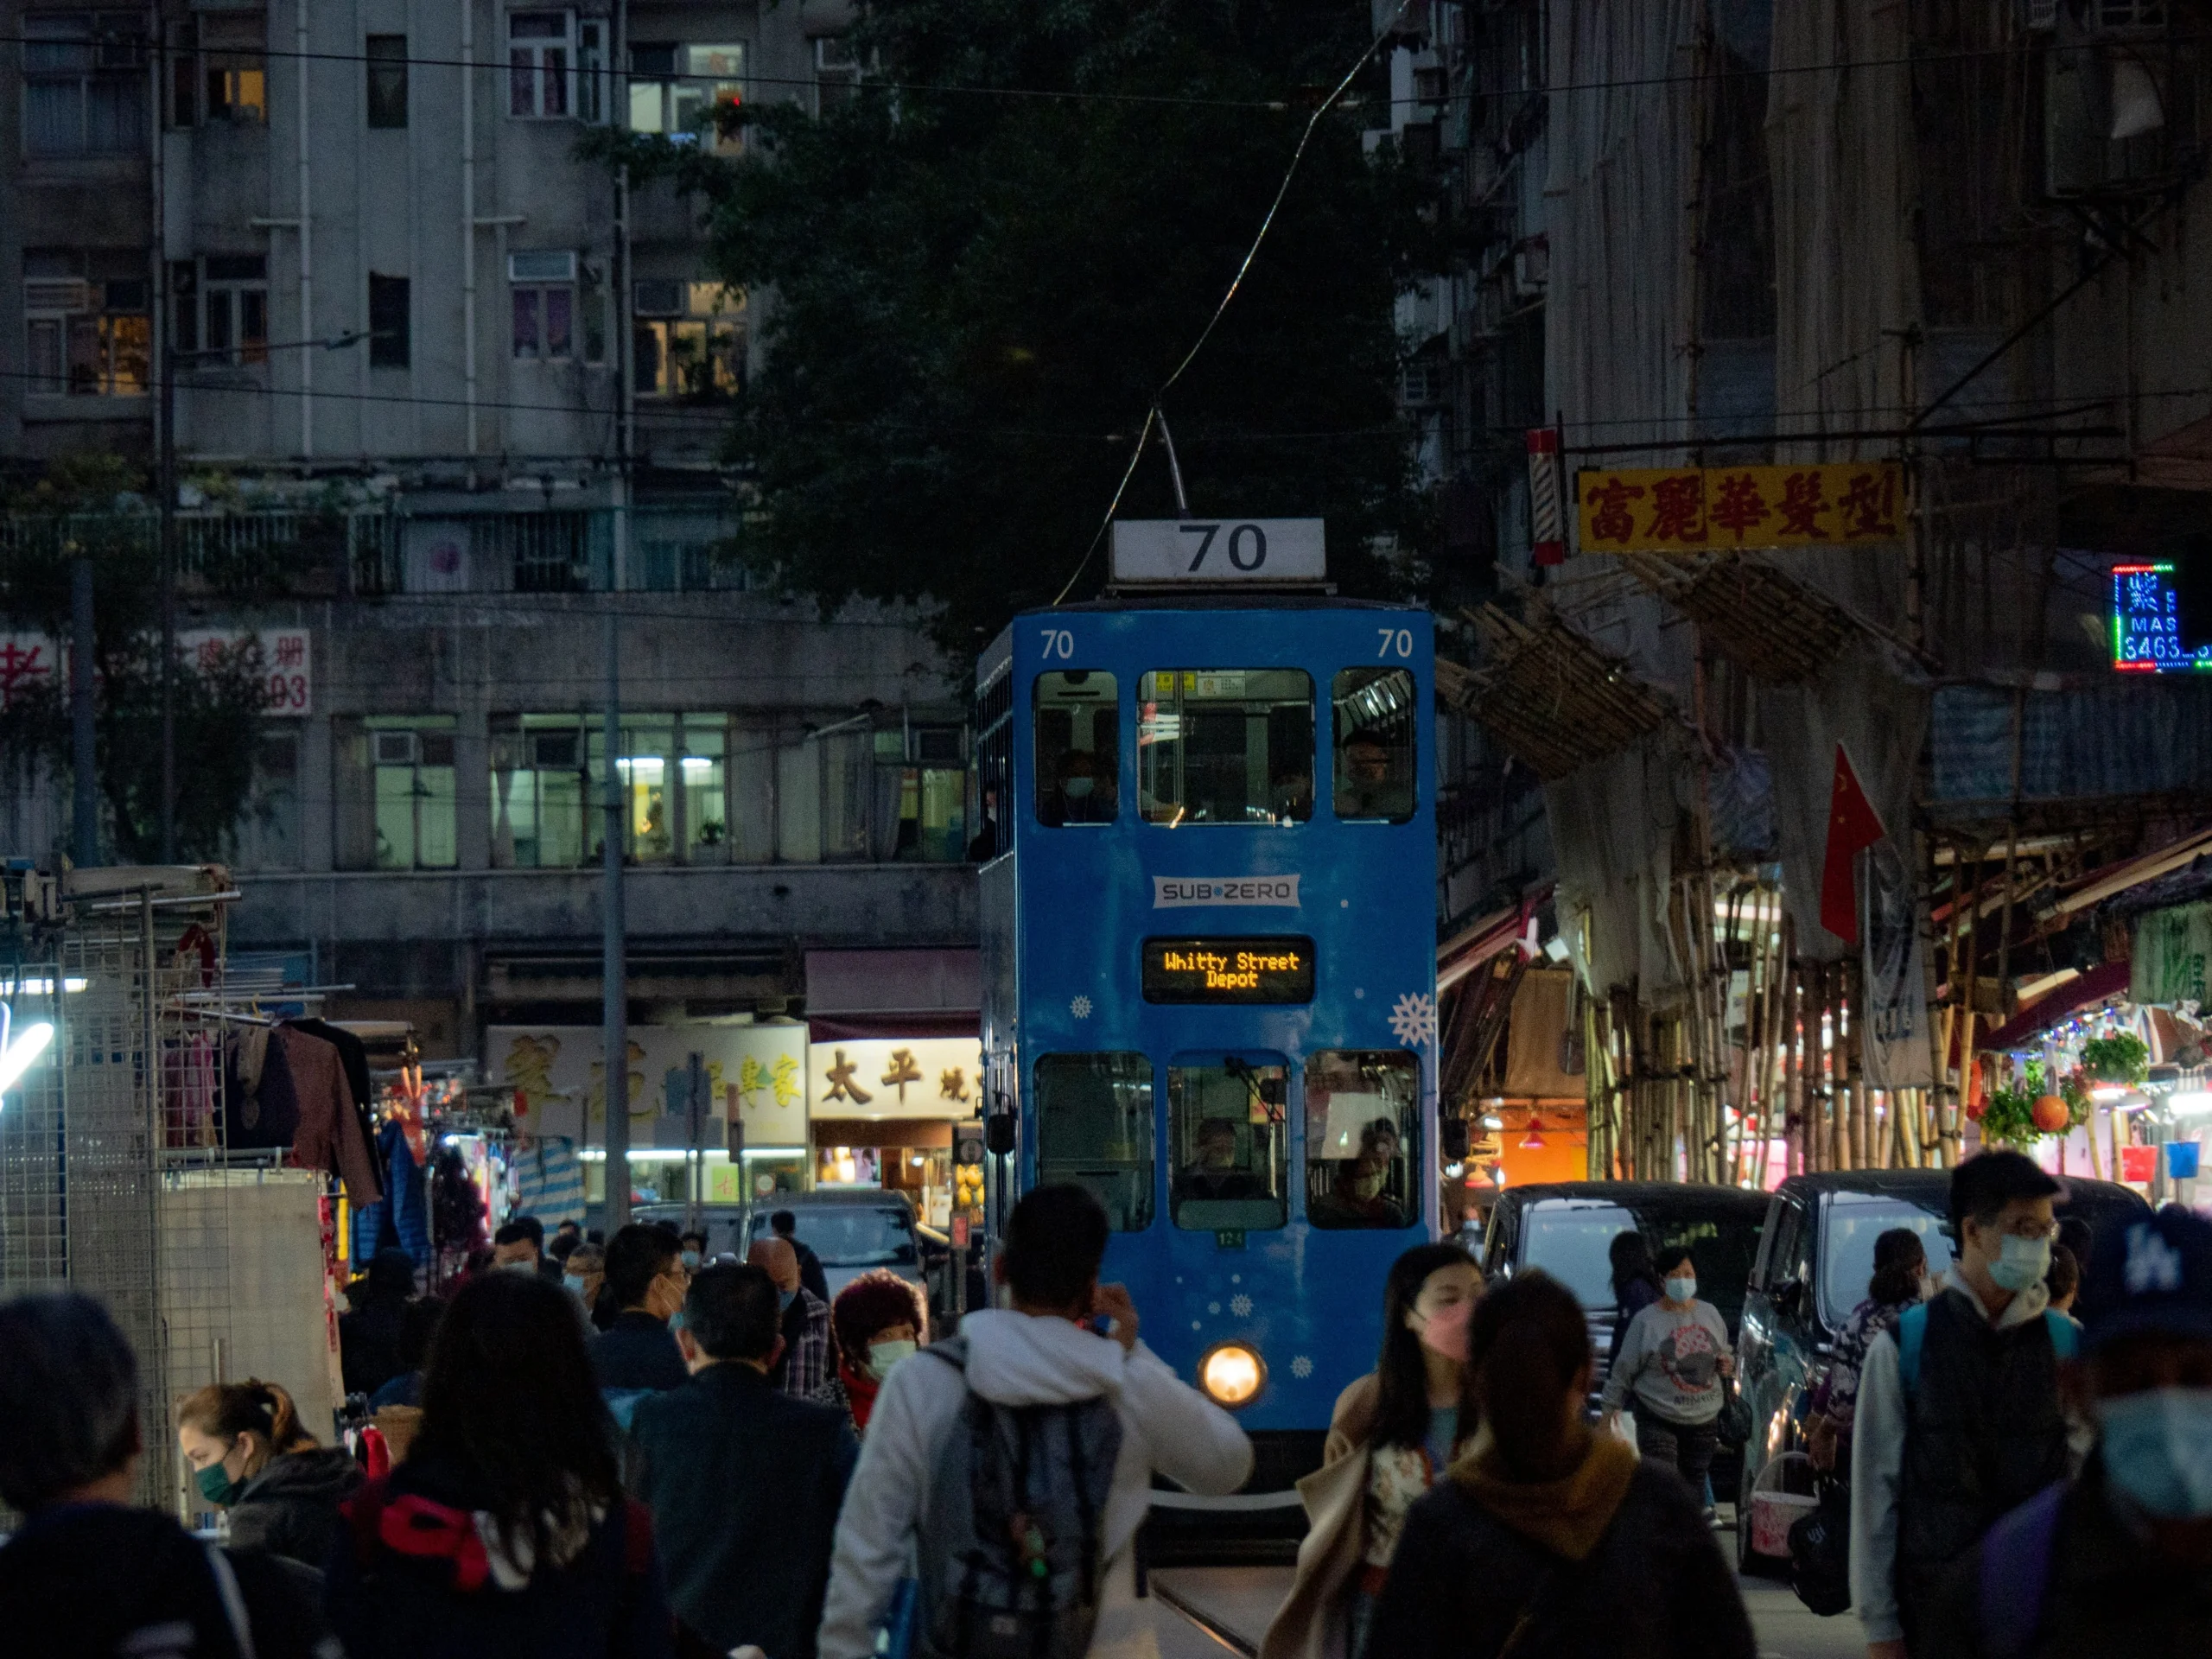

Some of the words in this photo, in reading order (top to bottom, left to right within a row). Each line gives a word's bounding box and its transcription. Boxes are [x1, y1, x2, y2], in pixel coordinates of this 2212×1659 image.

[1586, 470, 1897, 543] 富麗華髮型
[1179, 524, 1268, 572] 70
[1040, 630, 1074, 659] 70
[1377, 629, 1413, 658] 70
[1164, 952, 1228, 972] Whitty
[1236, 951, 1300, 971] Street
[1205, 970, 1259, 990] Depot
[822, 1048, 982, 1106] 太平燒
